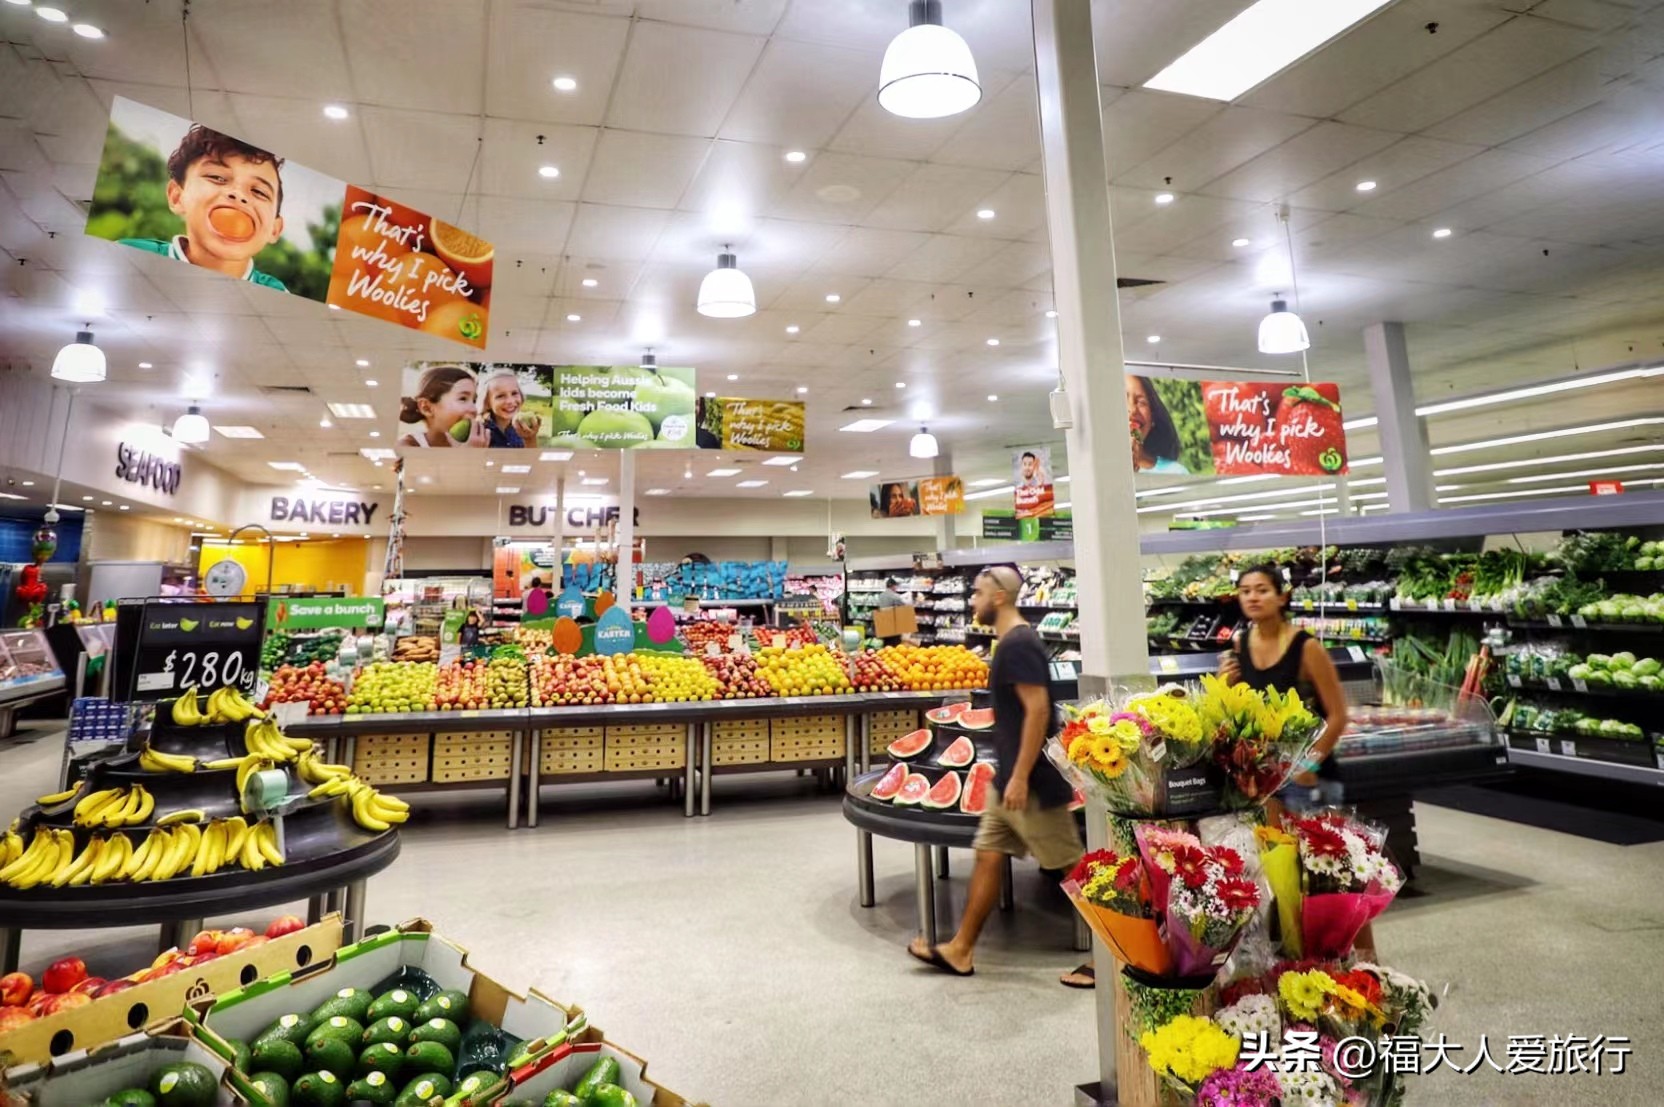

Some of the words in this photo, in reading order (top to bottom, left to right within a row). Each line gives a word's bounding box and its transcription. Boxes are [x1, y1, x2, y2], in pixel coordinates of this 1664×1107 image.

[352, 201, 425, 253] That's
[352, 240, 403, 284] why
[408, 258, 424, 279] I
[422, 268, 474, 297] pick
[347, 269, 430, 322] Woolies
[559, 387, 587, 398] kids
[587, 387, 637, 399] become
[560, 374, 610, 387] Helping
[559, 401, 595, 412] Fresh
[596, 401, 629, 412] Food
[630, 401, 657, 412] Kids
[1207, 386, 1271, 416] That's
[729, 418, 755, 435] why
[765, 420, 793, 434] pick
[730, 432, 772, 448] Woolies
[1219, 413, 1261, 446] why
[1265, 418, 1276, 437] I
[1280, 415, 1325, 445] pick
[116, 441, 182, 496] SEAFOOD
[1225, 440, 1292, 469] Woolies
[270, 496, 379, 525] BAKERY
[290, 604, 322, 616] Save
[324, 606, 333, 615] a
[335, 603, 375, 615] bunch
[1168, 778, 1193, 789] Bouquet
[1193, 777, 1206, 787] Bags
